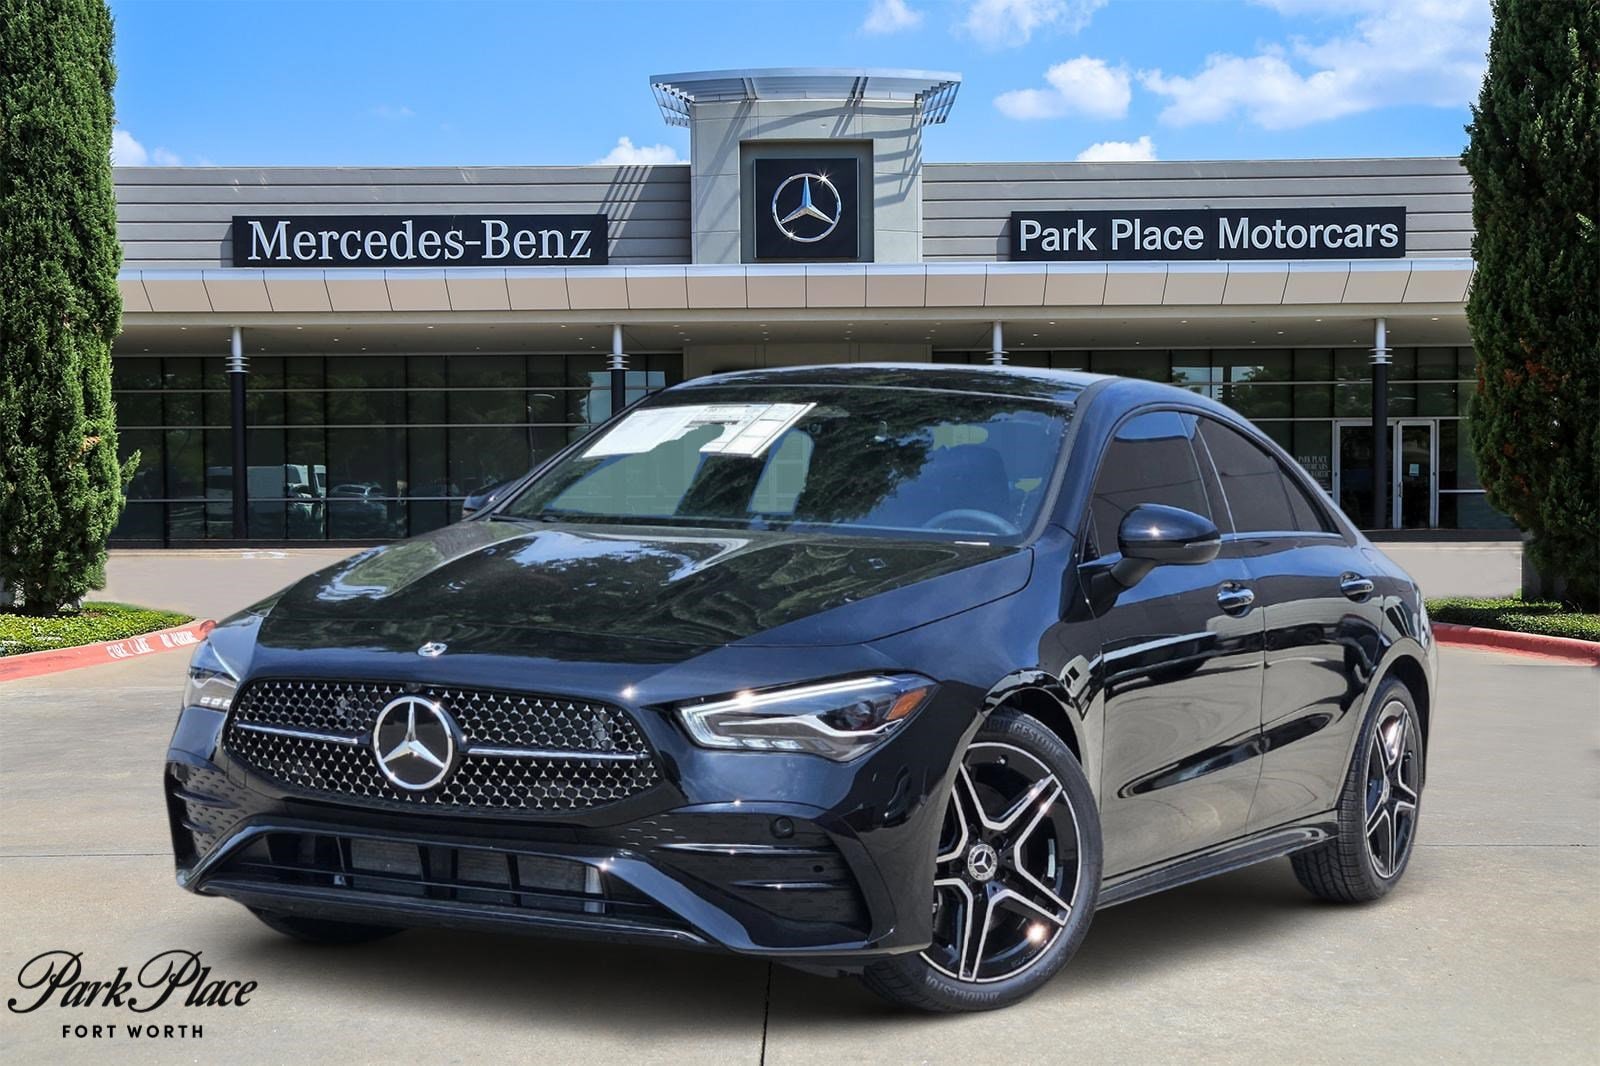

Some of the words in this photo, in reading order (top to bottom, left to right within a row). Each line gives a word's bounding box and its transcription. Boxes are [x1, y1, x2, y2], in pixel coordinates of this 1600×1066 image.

[247, 219, 593, 261] Mercedes-Benz
[1019, 219, 1098, 252] Park
[1111, 218, 1205, 251] Place
[1218, 216, 1400, 250] Motorcars
